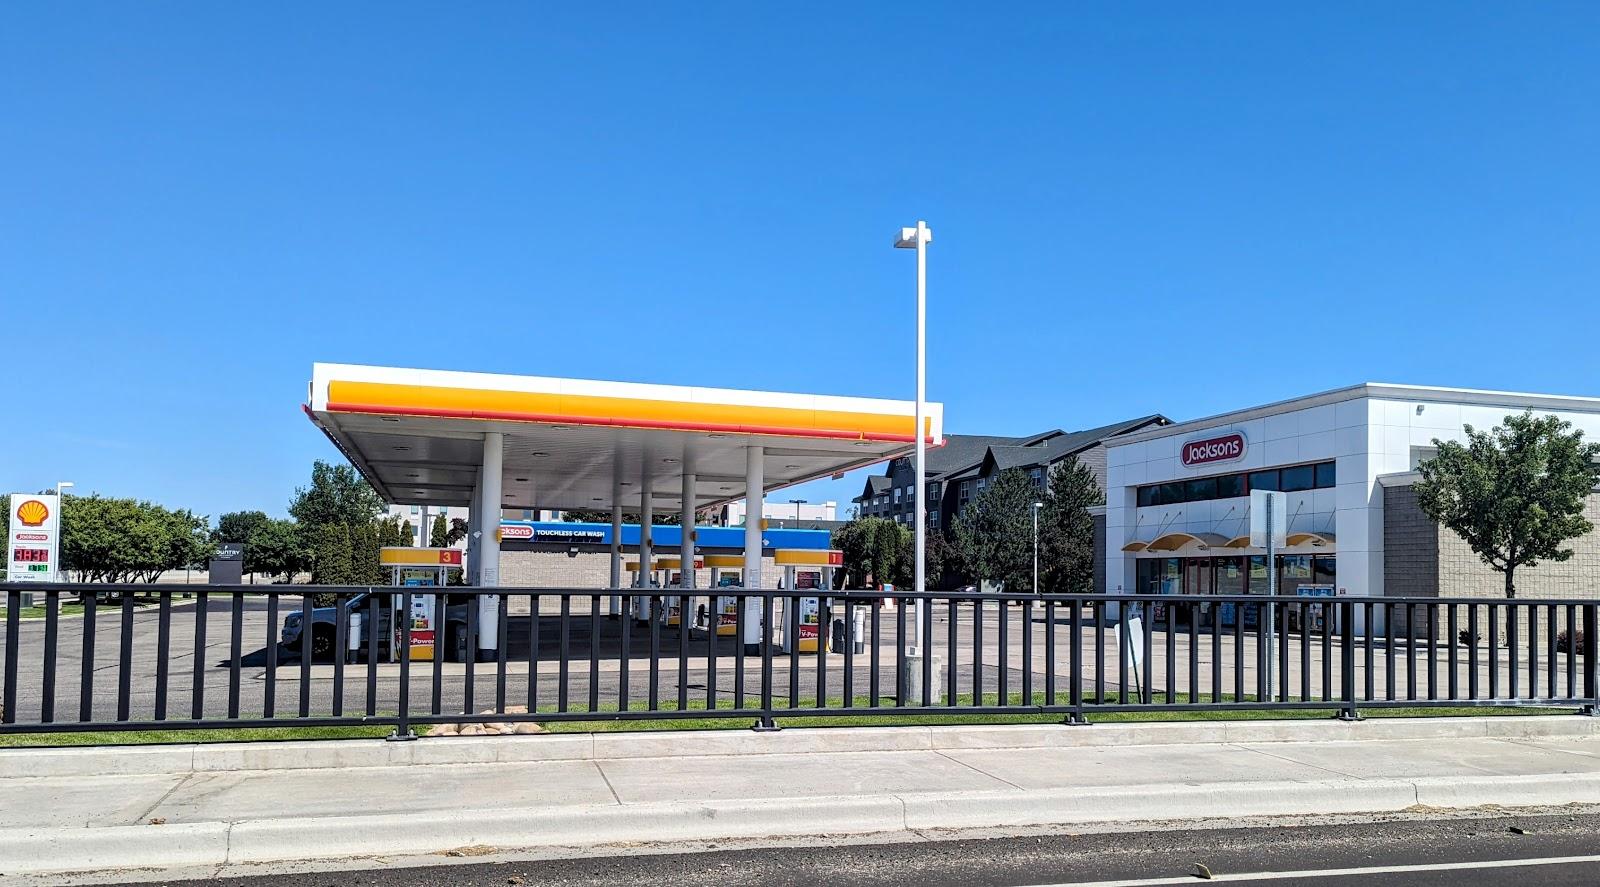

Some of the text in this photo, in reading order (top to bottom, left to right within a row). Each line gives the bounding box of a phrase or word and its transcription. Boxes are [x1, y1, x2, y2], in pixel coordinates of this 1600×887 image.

[1186, 440, 1239, 464] Jacksons
[501, 527, 530, 535] cksons
[443, 552, 451, 562] 3
[832, 553, 836, 563] 1
